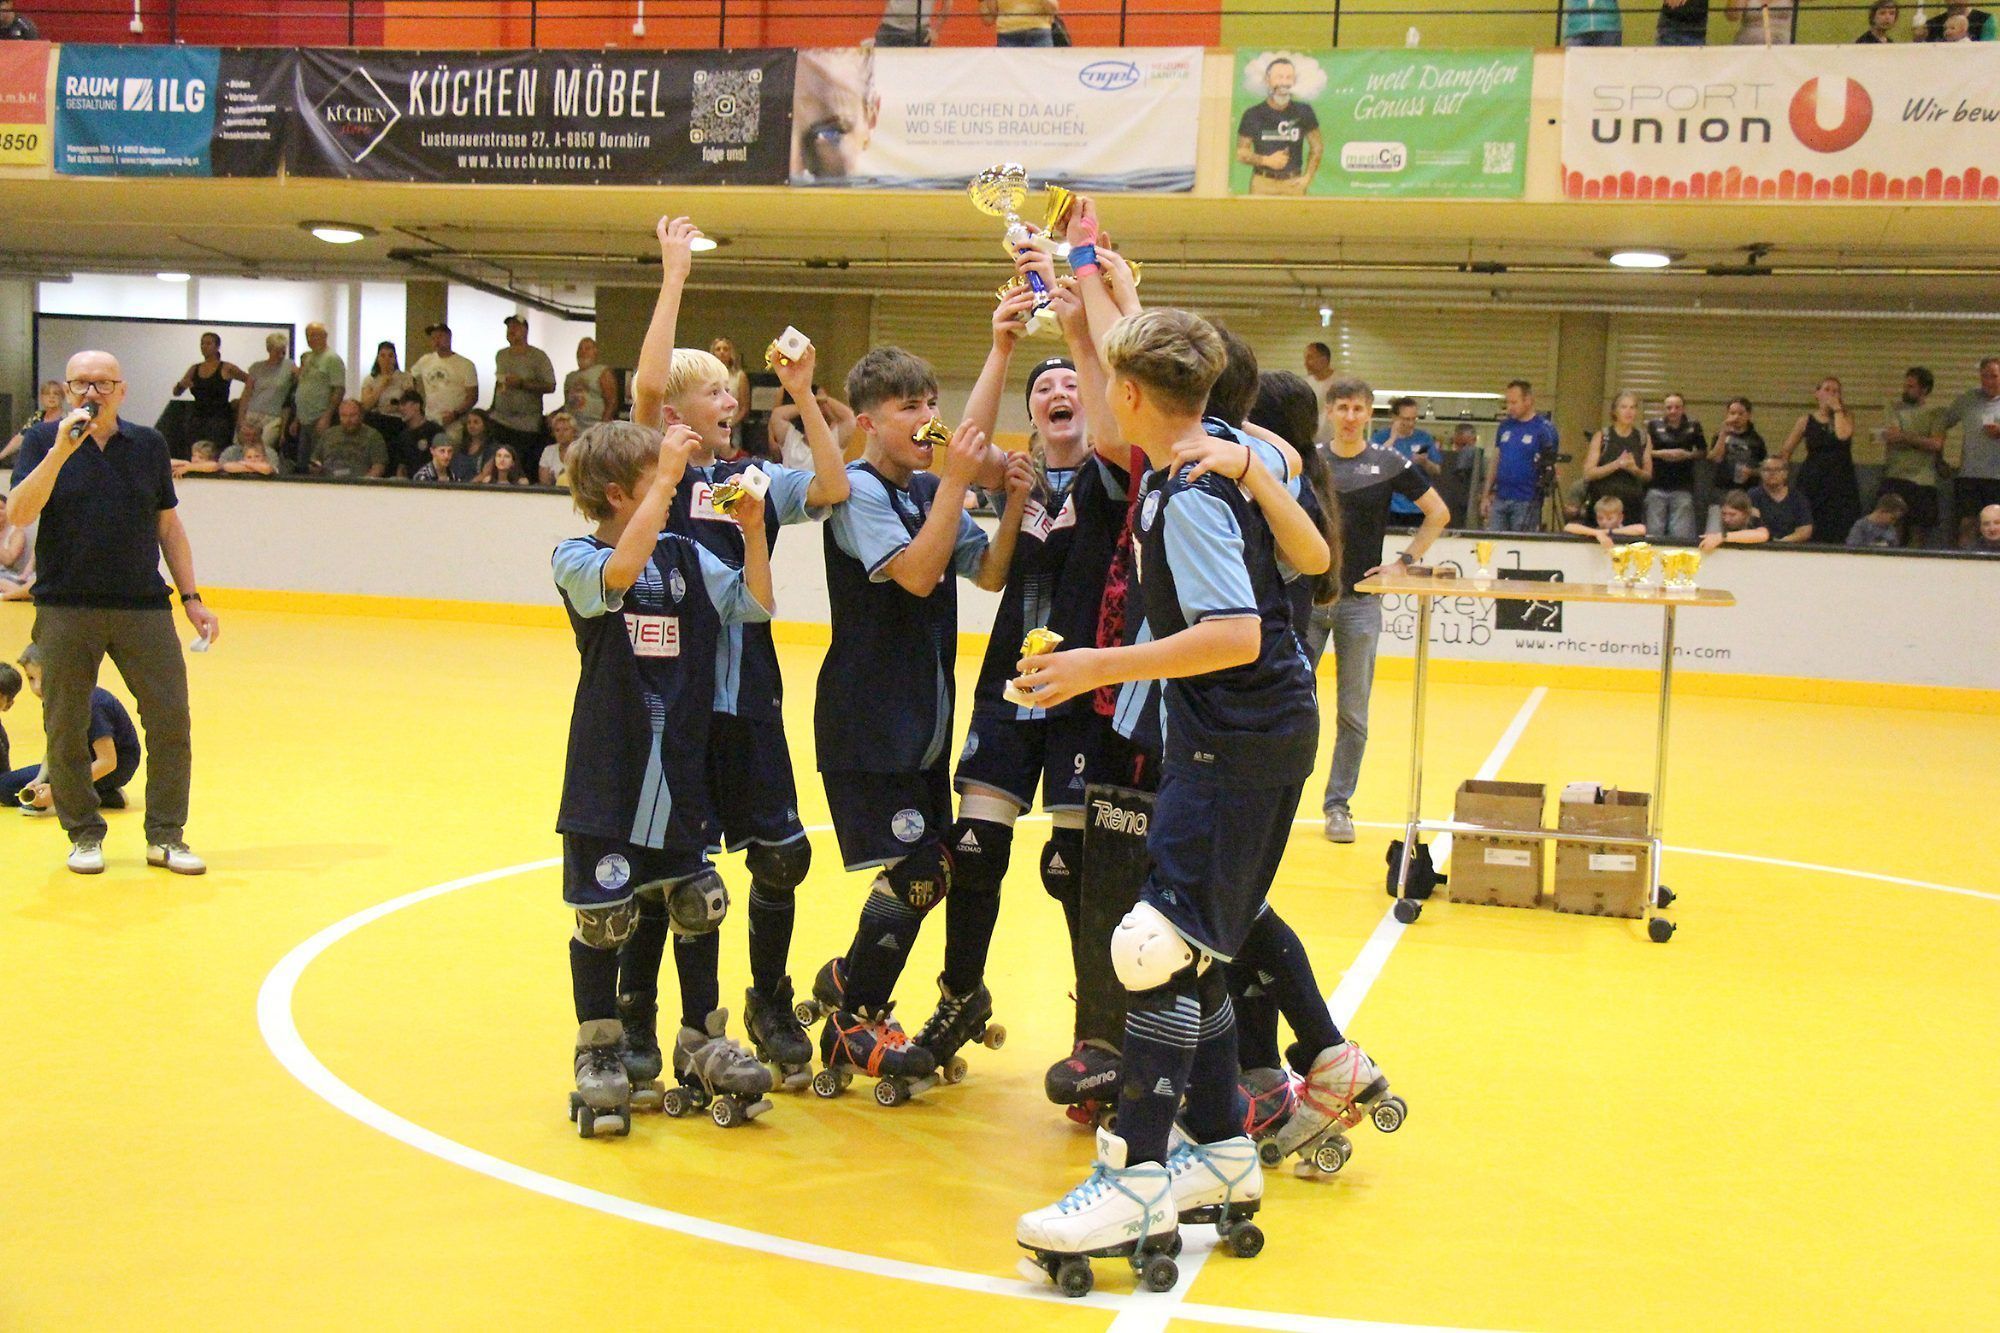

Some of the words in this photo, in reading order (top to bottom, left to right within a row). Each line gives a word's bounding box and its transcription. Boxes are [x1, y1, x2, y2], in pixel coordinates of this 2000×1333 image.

[65, 76, 119, 97] RAUM
[1366, 65, 1415, 92] weil
[1418, 60, 1519, 95] Dampfen
[159, 78, 206, 113] ILG
[408, 64, 538, 118] KÜCHEN
[553, 63, 666, 118] MÖBEL
[1593, 83, 1774, 112] SPORT
[65, 98, 117, 111] GESTALTUNG
[906, 103, 935, 117] WIR
[942, 103, 1014, 118] TAUCHEN
[1019, 103, 1038, 118] DA
[1354, 94, 1426, 121] Genuss
[1903, 98, 1949, 122] Wir
[1952, 99, 2000, 122] bew
[421, 130, 527, 148] Lustenauerstrasse
[554, 131, 596, 149] A-6850
[600, 131, 651, 149] Dornbirn
[906, 120, 930, 135] WO
[934, 120, 957, 135] SIE
[962, 120, 993, 136] UNS
[999, 121, 1088, 136] BRAUCHEN.
[1591, 117, 1772, 144] union
[457, 152, 612, 170] www.kuechenstore.at
[1393, 613, 1491, 646] Cub
[1515, 638, 1732, 660] www.rhc-dornbin.com
[1073, 752, 1086, 775] 9
[1131, 752, 1146, 785] 1
[1092, 799, 1148, 836] Reno
